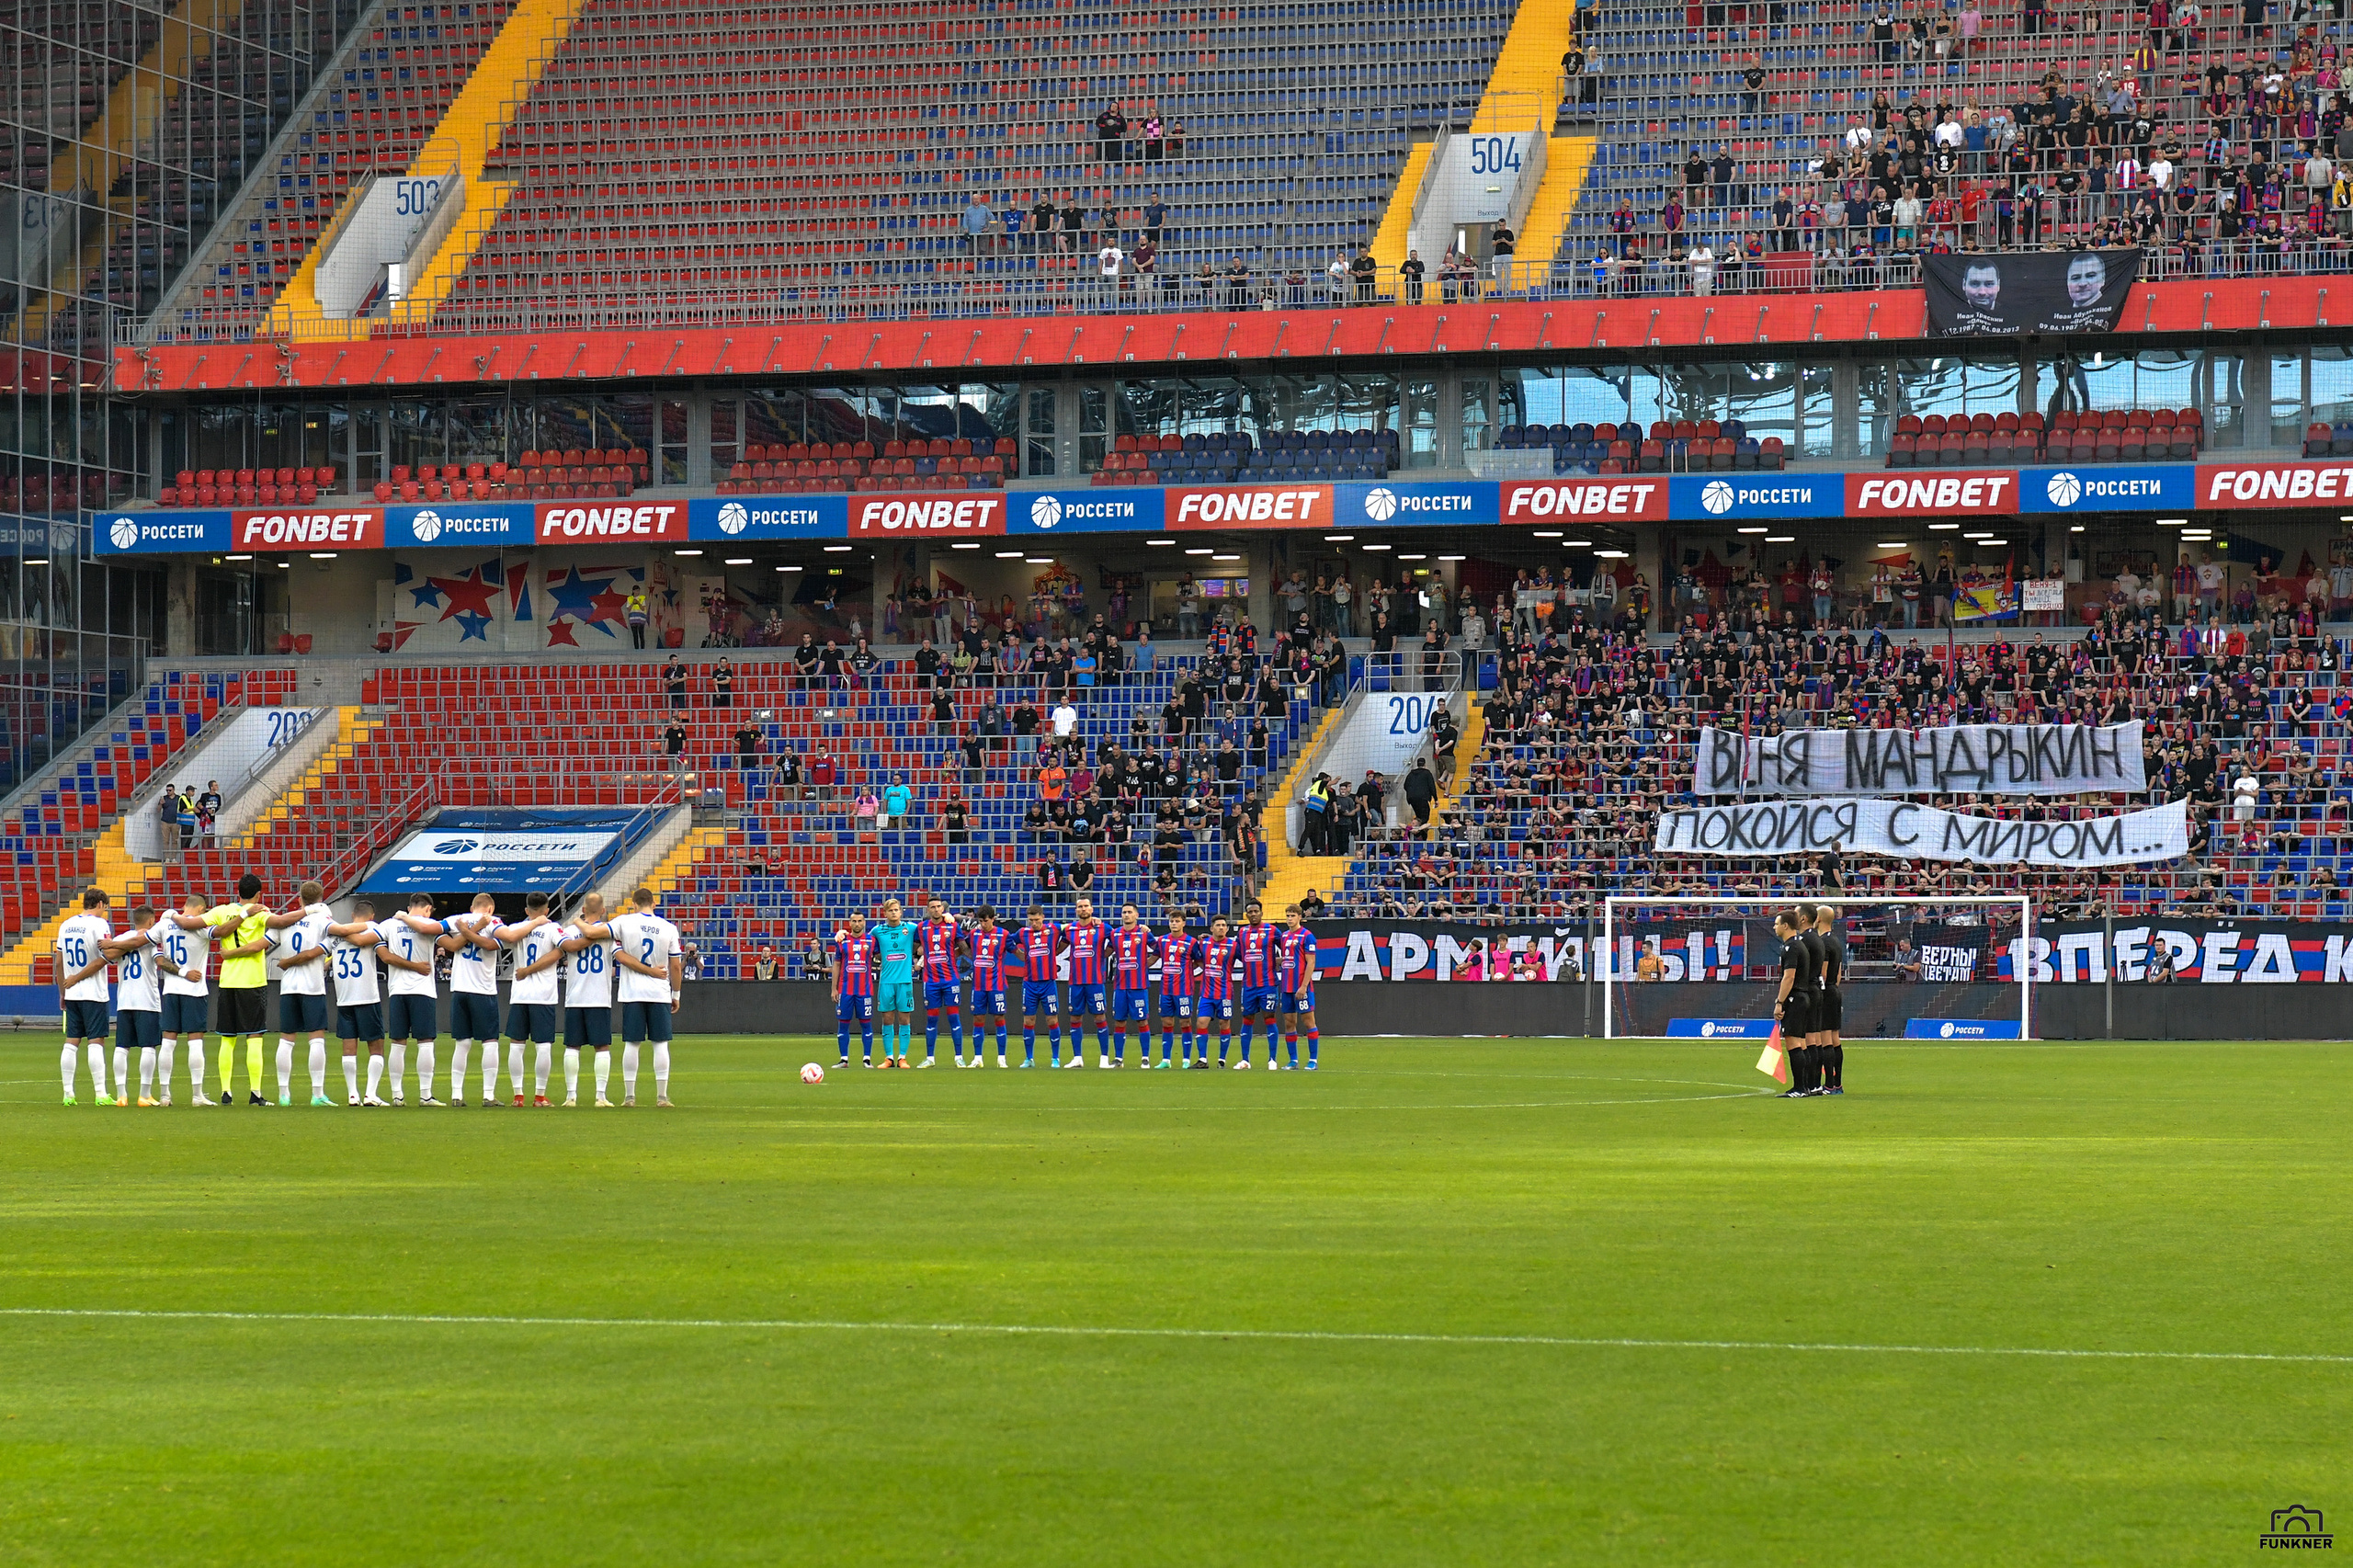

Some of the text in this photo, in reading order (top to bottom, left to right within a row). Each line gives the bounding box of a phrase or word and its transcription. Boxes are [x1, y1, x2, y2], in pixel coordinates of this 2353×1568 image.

[1471, 136, 1521, 175] 504
[1477, 210, 1499, 218] Выход
[1857, 477, 2010, 509] FONBET
[2085, 479, 2161, 497] РОССЕТИ
[2209, 468, 2353, 500] FONBET
[1401, 495, 1472, 512] РОССЕТИ
[1507, 483, 1655, 517] FONBET
[1738, 487, 1812, 505] РОССЕТИ
[860, 500, 998, 529] FONBET
[1065, 502, 1134, 518] РОССЕТИ
[1177, 491, 1320, 522] FONBET
[445, 517, 509, 533] РОССЕТИ
[541, 506, 676, 537] FONBET
[752, 509, 818, 525] РОССЕТИ
[142, 524, 204, 540] РОССЕТИ
[243, 514, 372, 543] FONBET
[1846, 725, 2122, 792] МАНДРЫКИН
[1667, 801, 2163, 859] ПОКОЙСЯ С МИРОМ...
[481, 842, 579, 851] РОССЕТИ
[64, 937, 87, 968] 56
[166, 935, 188, 965] 15
[291, 932, 302, 955] 9
[402, 937, 413, 961] 7
[641, 937, 654, 968] 2
[2007, 920, 2300, 983] ВПЕРЁД
[121, 949, 142, 981] 28
[337, 948, 363, 980] 33
[526, 943, 537, 968] 8
[576, 943, 604, 974] 88
[1921, 945, 1976, 966] ВЕРНЫ
[1924, 965, 1972, 982] ЦВЕТАМ
[954, 994, 959, 1004] 4
[995, 1002, 1006, 1012] 72
[1049, 1003, 1057, 1013] 14
[1096, 1001, 1105, 1011] 91
[1299, 1000, 1309, 1010] 68
[864, 1006, 872, 1016] 22
[1138, 1007, 1144, 1017] 5
[1179, 1006, 1190, 1016] 80
[1222, 1006, 1233, 1017] 88
[1715, 1025, 1745, 1034] РОССЕТИ
[1955, 1026, 1984, 1035] РОССЕТИ
